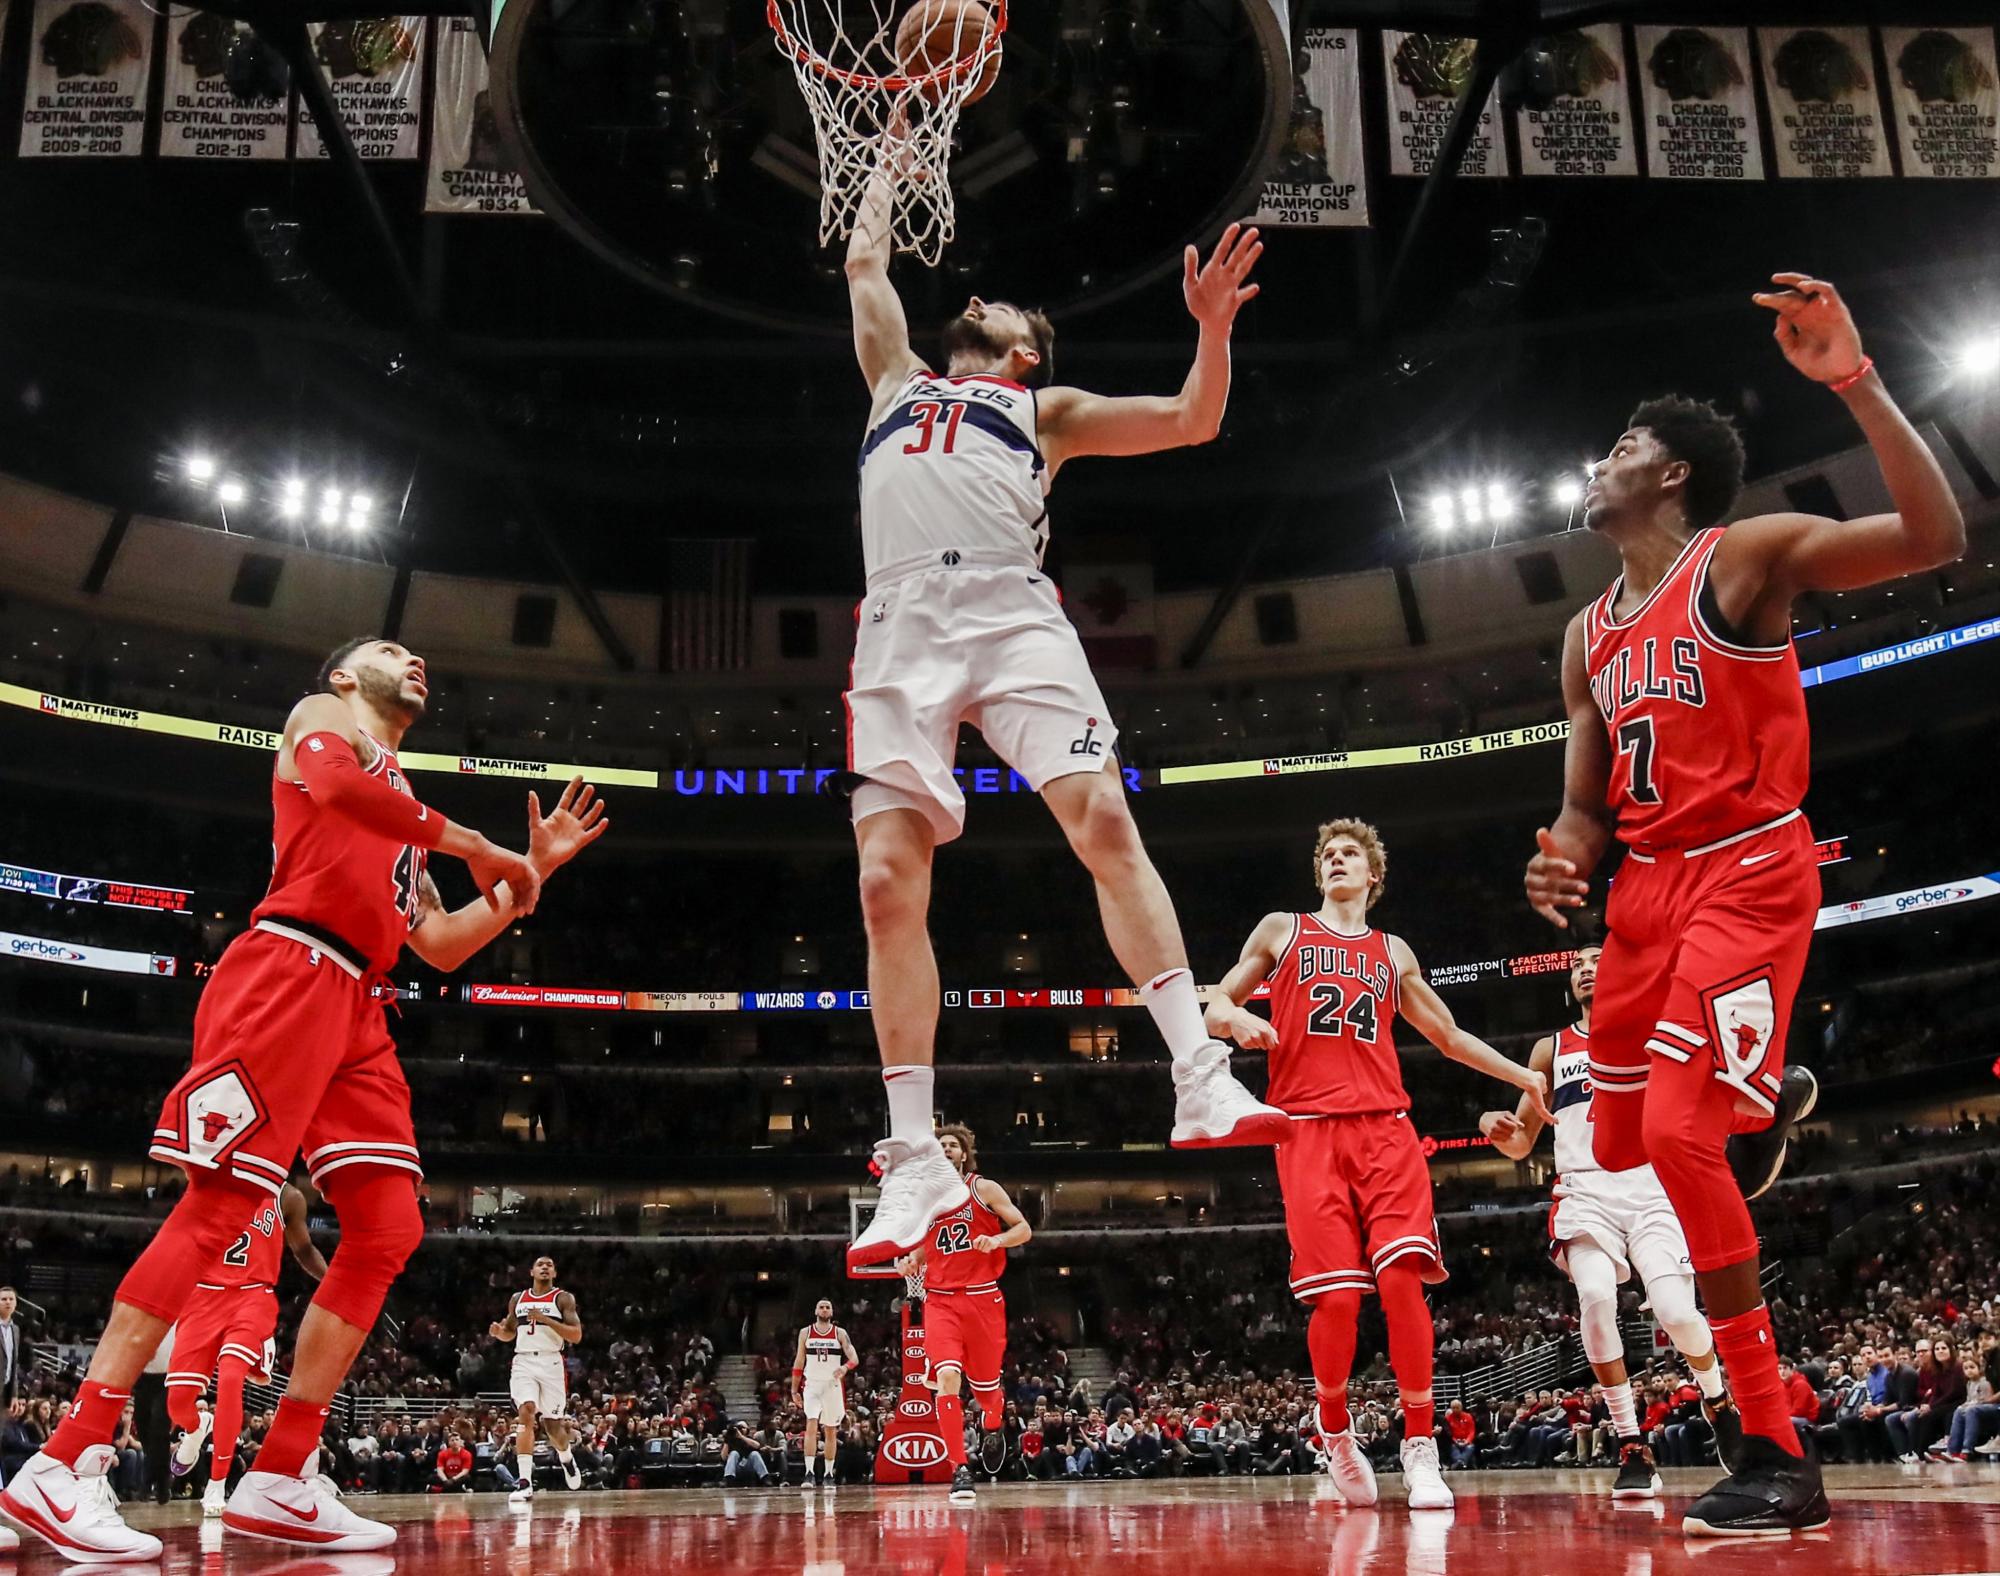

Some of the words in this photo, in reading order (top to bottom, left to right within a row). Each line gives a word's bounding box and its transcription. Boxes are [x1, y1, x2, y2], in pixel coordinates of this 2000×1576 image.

[57, 81, 118, 93] CHICAGO
[196, 80, 230, 93] CHIC
[331, 82, 391, 94] CHICAGO
[37, 95, 134, 108] BLACKHAWKS
[337, 97, 408, 109] CKHAWKS
[1415, 100, 1455, 112] CHICA
[1672, 104, 1728, 116] CHICAGO
[1798, 104, 1854, 115] CHICAGO
[1922, 104, 1978, 115] CHICAGO
[24, 110, 86, 123] CENTRAL
[89, 111, 144, 122] DIVISION
[164, 110, 227, 124] CENTRAL
[231, 113, 286, 125] DIVISION
[365, 113, 418, 125] DIVISION
[1529, 112, 1620, 124] BLACKHAWKS
[1656, 115, 1746, 128] BLACKHAWKS
[1784, 115, 1873, 127] BLACKHAWKS
[1908, 114, 1996, 127] BLACKHAWKS
[42, 125, 123, 137] CHAMPIONS
[182, 127, 266, 140] CHAMPIONS
[1542, 124, 1609, 136] WESTERN
[1669, 129, 1736, 140] WESTERN
[1795, 128, 1865, 140] CAMPBELL
[1919, 128, 1989, 140] CAMPBELL
[41, 140, 121, 152] 2009-2010
[1532, 136, 1622, 149] CONFERENCE
[1660, 140, 1748, 153] CONFERENCE
[1790, 140, 1876, 152] CONFERENCE
[1913, 139, 1999, 152] CONFERENCE
[196, 143, 251, 156] 2012-13
[1540, 149, 1617, 161] CHAMPIONS
[1667, 153, 1743, 165] CHAMPIONS
[1797, 152, 1872, 164] CHAMPIONS
[1921, 152, 1995, 163] CHAMPIONS
[1555, 162, 1605, 174] 2012-13
[1669, 165, 1744, 177] 2009-2010
[442, 170, 518, 183] STANLEY
[449, 184, 527, 197] CHAMPIO
[1263, 185, 1312, 197] ANLEY
[1320, 185, 1356, 197] CUP
[478, 199, 520, 211] 1934
[1261, 198, 1349, 210] HAMPIONS
[1280, 211, 1319, 223] 2015
[903, 401, 968, 455] 31
[1861, 650, 1896, 669] BUD
[1897, 636, 1946, 660] LIGHT
[61, 699, 139, 720] MATTHEWS
[219, 726, 276, 748] RAISE
[1420, 739, 1472, 760] RAISE
[1480, 732, 1514, 750] THE
[1522, 722, 1571, 743] ROOF
[480, 759, 547, 772] MATTHEWS
[1282, 753, 1348, 767] MATTHEWS
[1618, 714, 1663, 805] 7
[675, 769, 837, 795] UNIT
[109, 884, 133, 896] THIS
[136, 888, 172, 900] HOUSE
[175, 892, 186, 901] IS
[109, 894, 130, 903] NOT
[134, 896, 154, 906] FOR
[158, 899, 184, 909] SALE
[1896, 888, 1951, 911] gerber
[11, 939, 66, 956] gerber
[1431, 960, 1500, 976] WASHINGTON
[1509, 953, 1558, 967] 4-FACTOR
[1298, 945, 1390, 1002] BULLS
[1431, 973, 1478, 986] CHICAGO
[1512, 961, 1567, 976] EFFECTIVE
[475, 987, 539, 1001] Budweiser
[544, 993, 596, 1004] CHAMPIONS
[596, 993, 619, 1005] CLUB
[647, 993, 687, 1001] TIMEOUTS
[698, 993, 725, 1001] FOULS
[756, 992, 804, 1009] WIZARDS
[983, 992, 992, 1004] 5
[1051, 990, 1083, 1005] BULLS
[664, 1001, 670, 1009] 7
[1307, 983, 1378, 1044] 24
[1441, 1138, 1468, 1150] FIRST
[936, 1222, 972, 1255] 42
[907, 1329, 925, 1339] ZTE
[816, 1348, 828, 1362] 13
[905, 1403, 927, 1414] KIA
[894, 1441, 939, 1460] KIA
